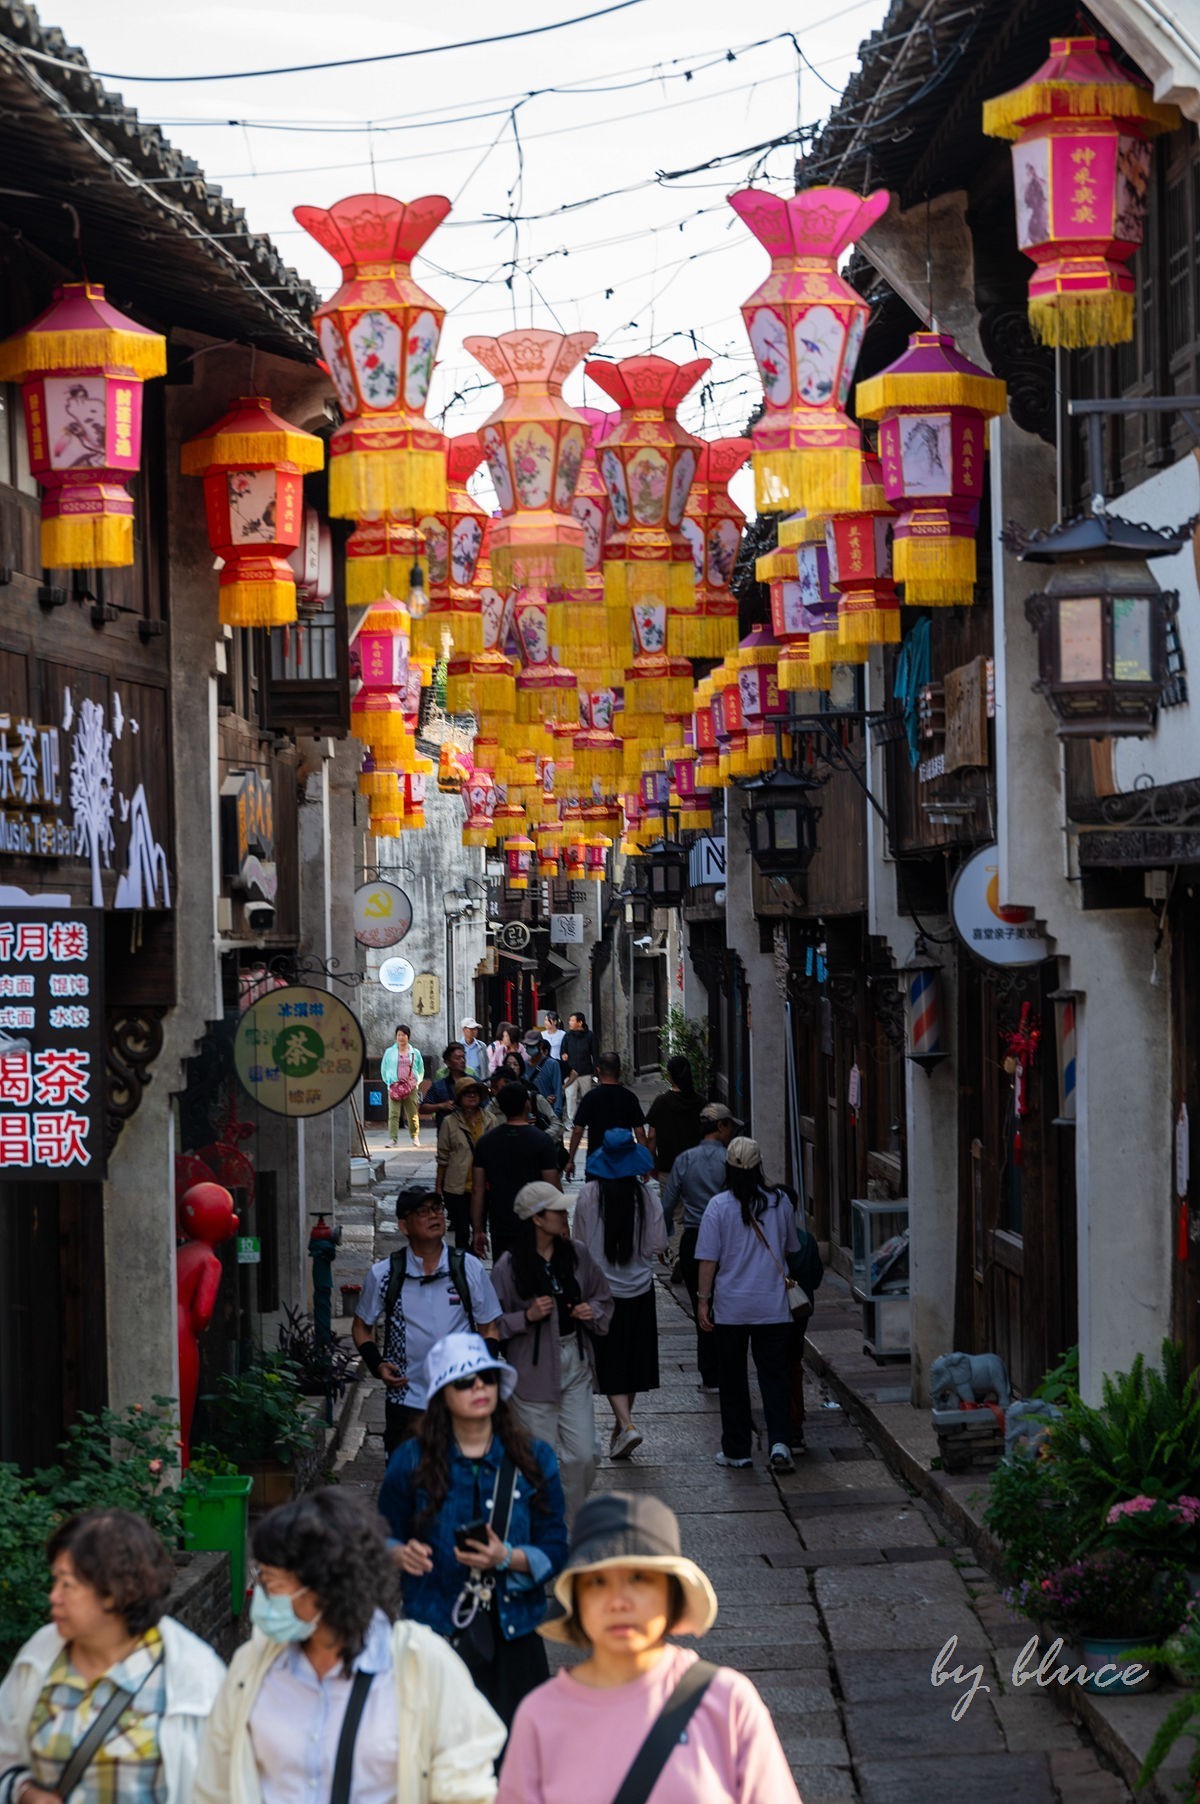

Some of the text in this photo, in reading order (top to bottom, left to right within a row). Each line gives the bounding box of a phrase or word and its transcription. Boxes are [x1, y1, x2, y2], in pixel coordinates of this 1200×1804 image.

[508, 926, 523, 940] 27
[49, 974, 89, 997] 馄饨
[49, 1005, 90, 1029] 水饺
[282, 1031, 318, 1066] 茶
